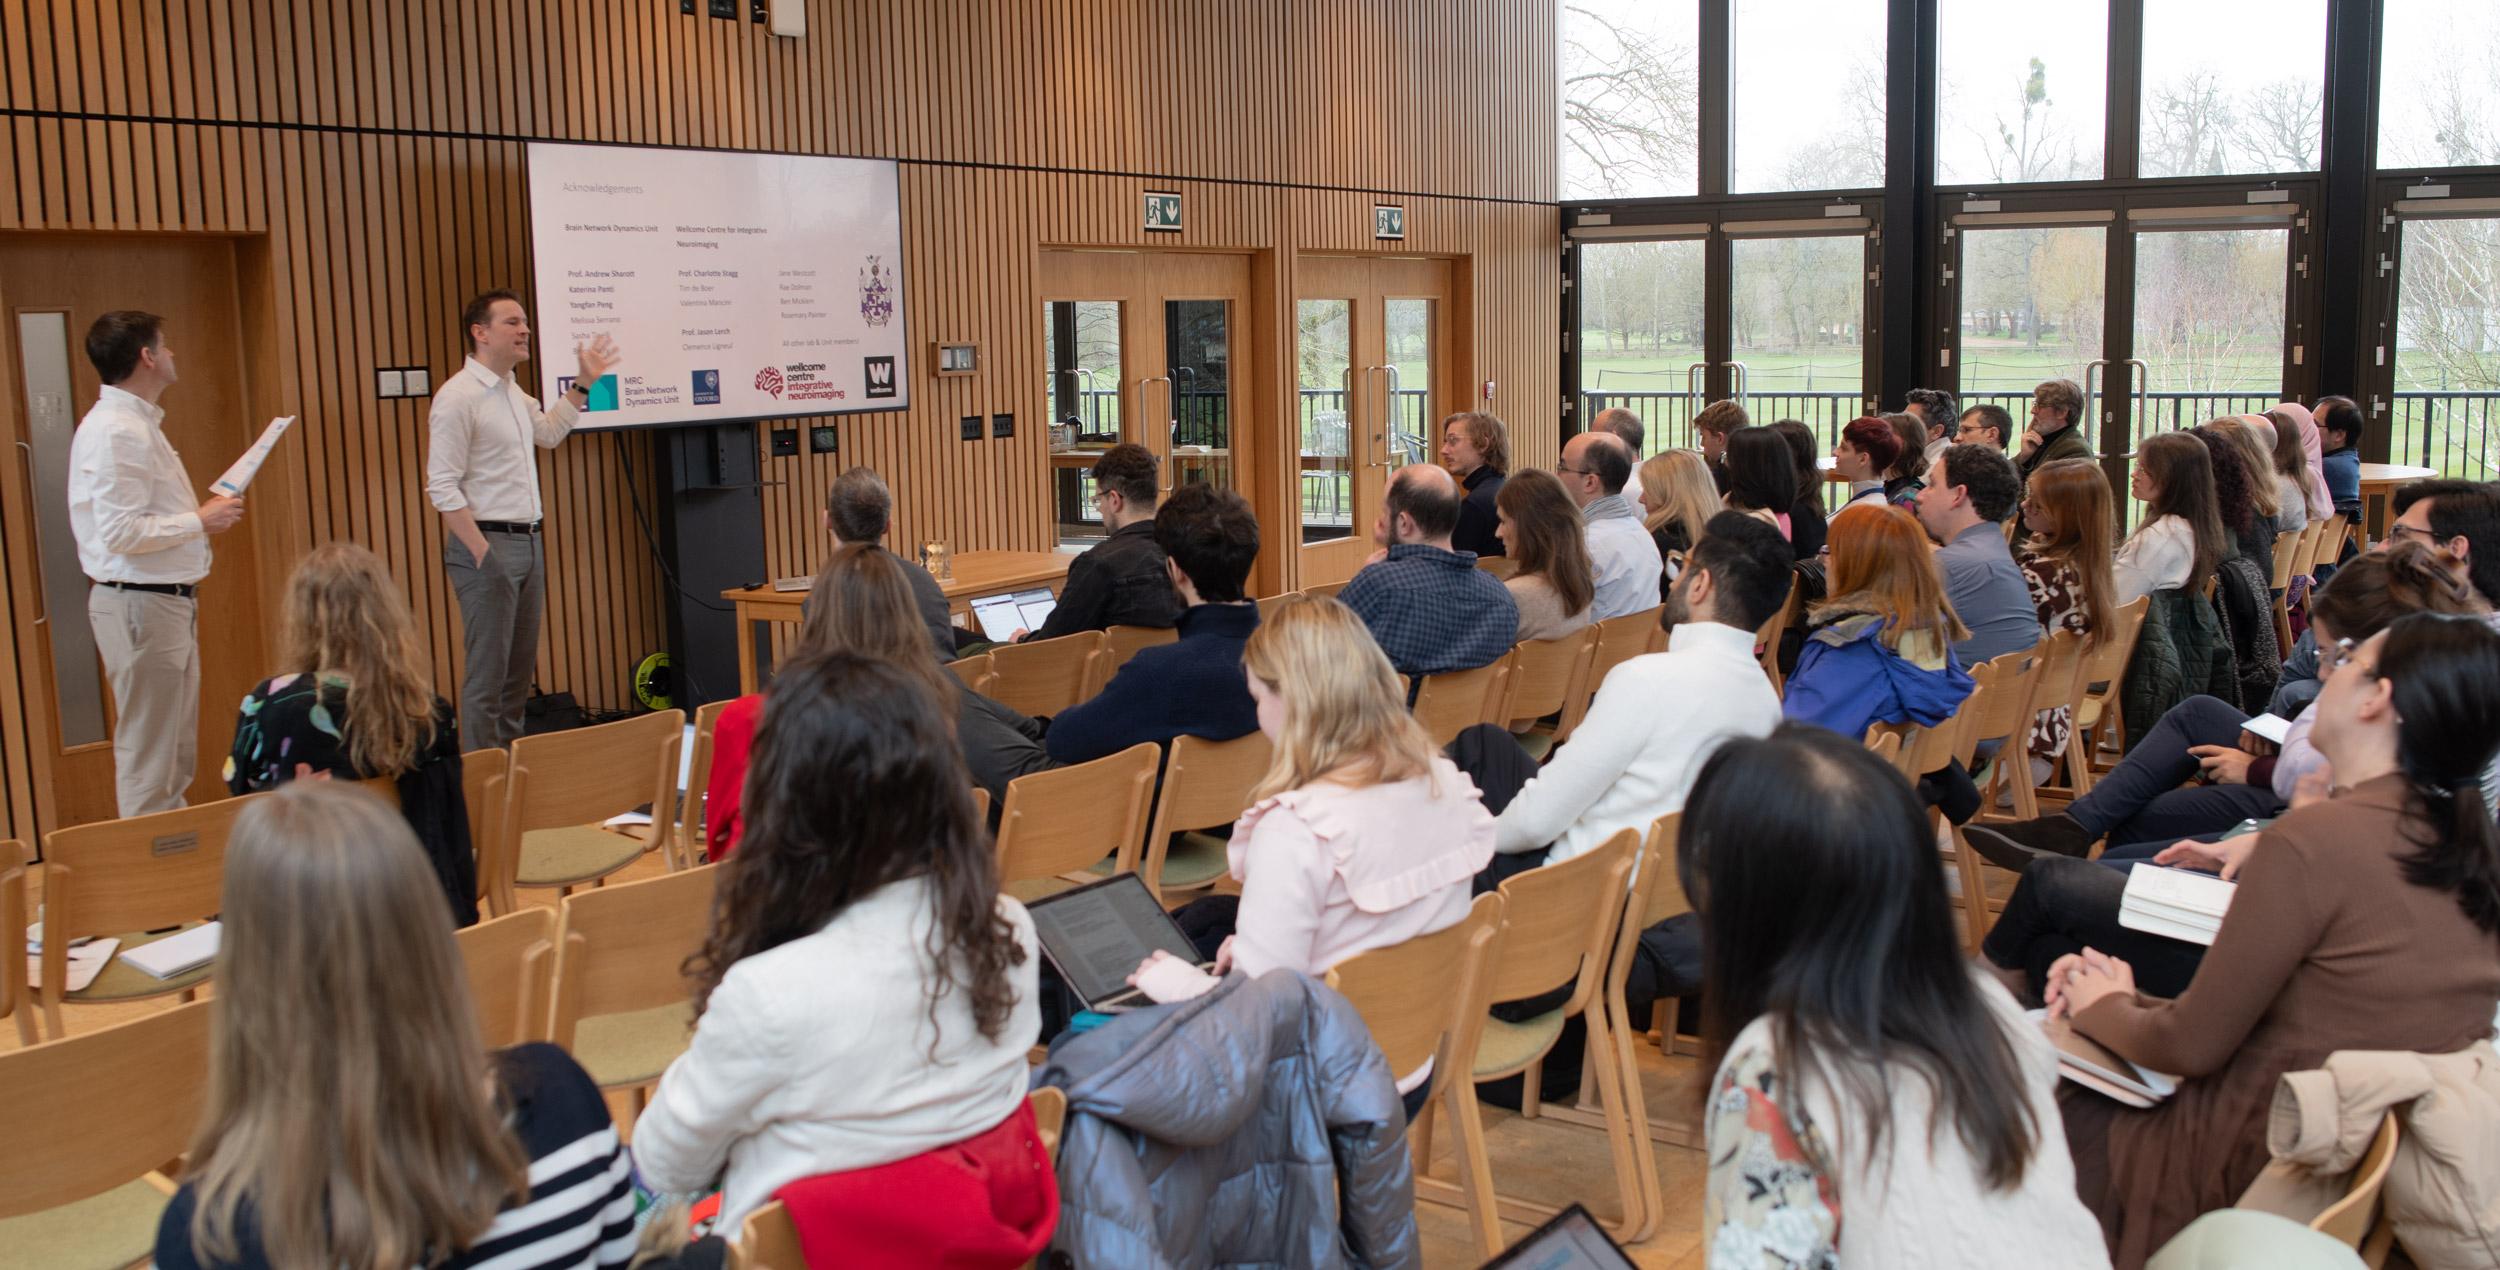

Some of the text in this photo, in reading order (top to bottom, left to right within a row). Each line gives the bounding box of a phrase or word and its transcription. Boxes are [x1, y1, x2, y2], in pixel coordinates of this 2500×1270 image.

[562, 182, 644, 195] Acknowledgements
[565, 224, 659, 233] Brain Network Dynamics Unit
[677, 241, 719, 249] Neuroimaging
[568, 270, 583, 278] Prof.
[585, 270, 610, 278] Andrew
[679, 270, 739, 279] Prof. Charlotte Stagg
[597, 301, 614, 310] Peng
[682, 328, 696, 336] Prof.
[786, 362, 826, 373] wellcome
[786, 372, 815, 381] centre
[868, 363, 891, 384] W
[624, 376, 643, 385] MRC
[625, 384, 678, 395] Brain Network
[787, 381, 834, 391] integrative
[788, 389, 845, 400] neuroimaging
[625, 395, 680, 407] Dynamics Unit
